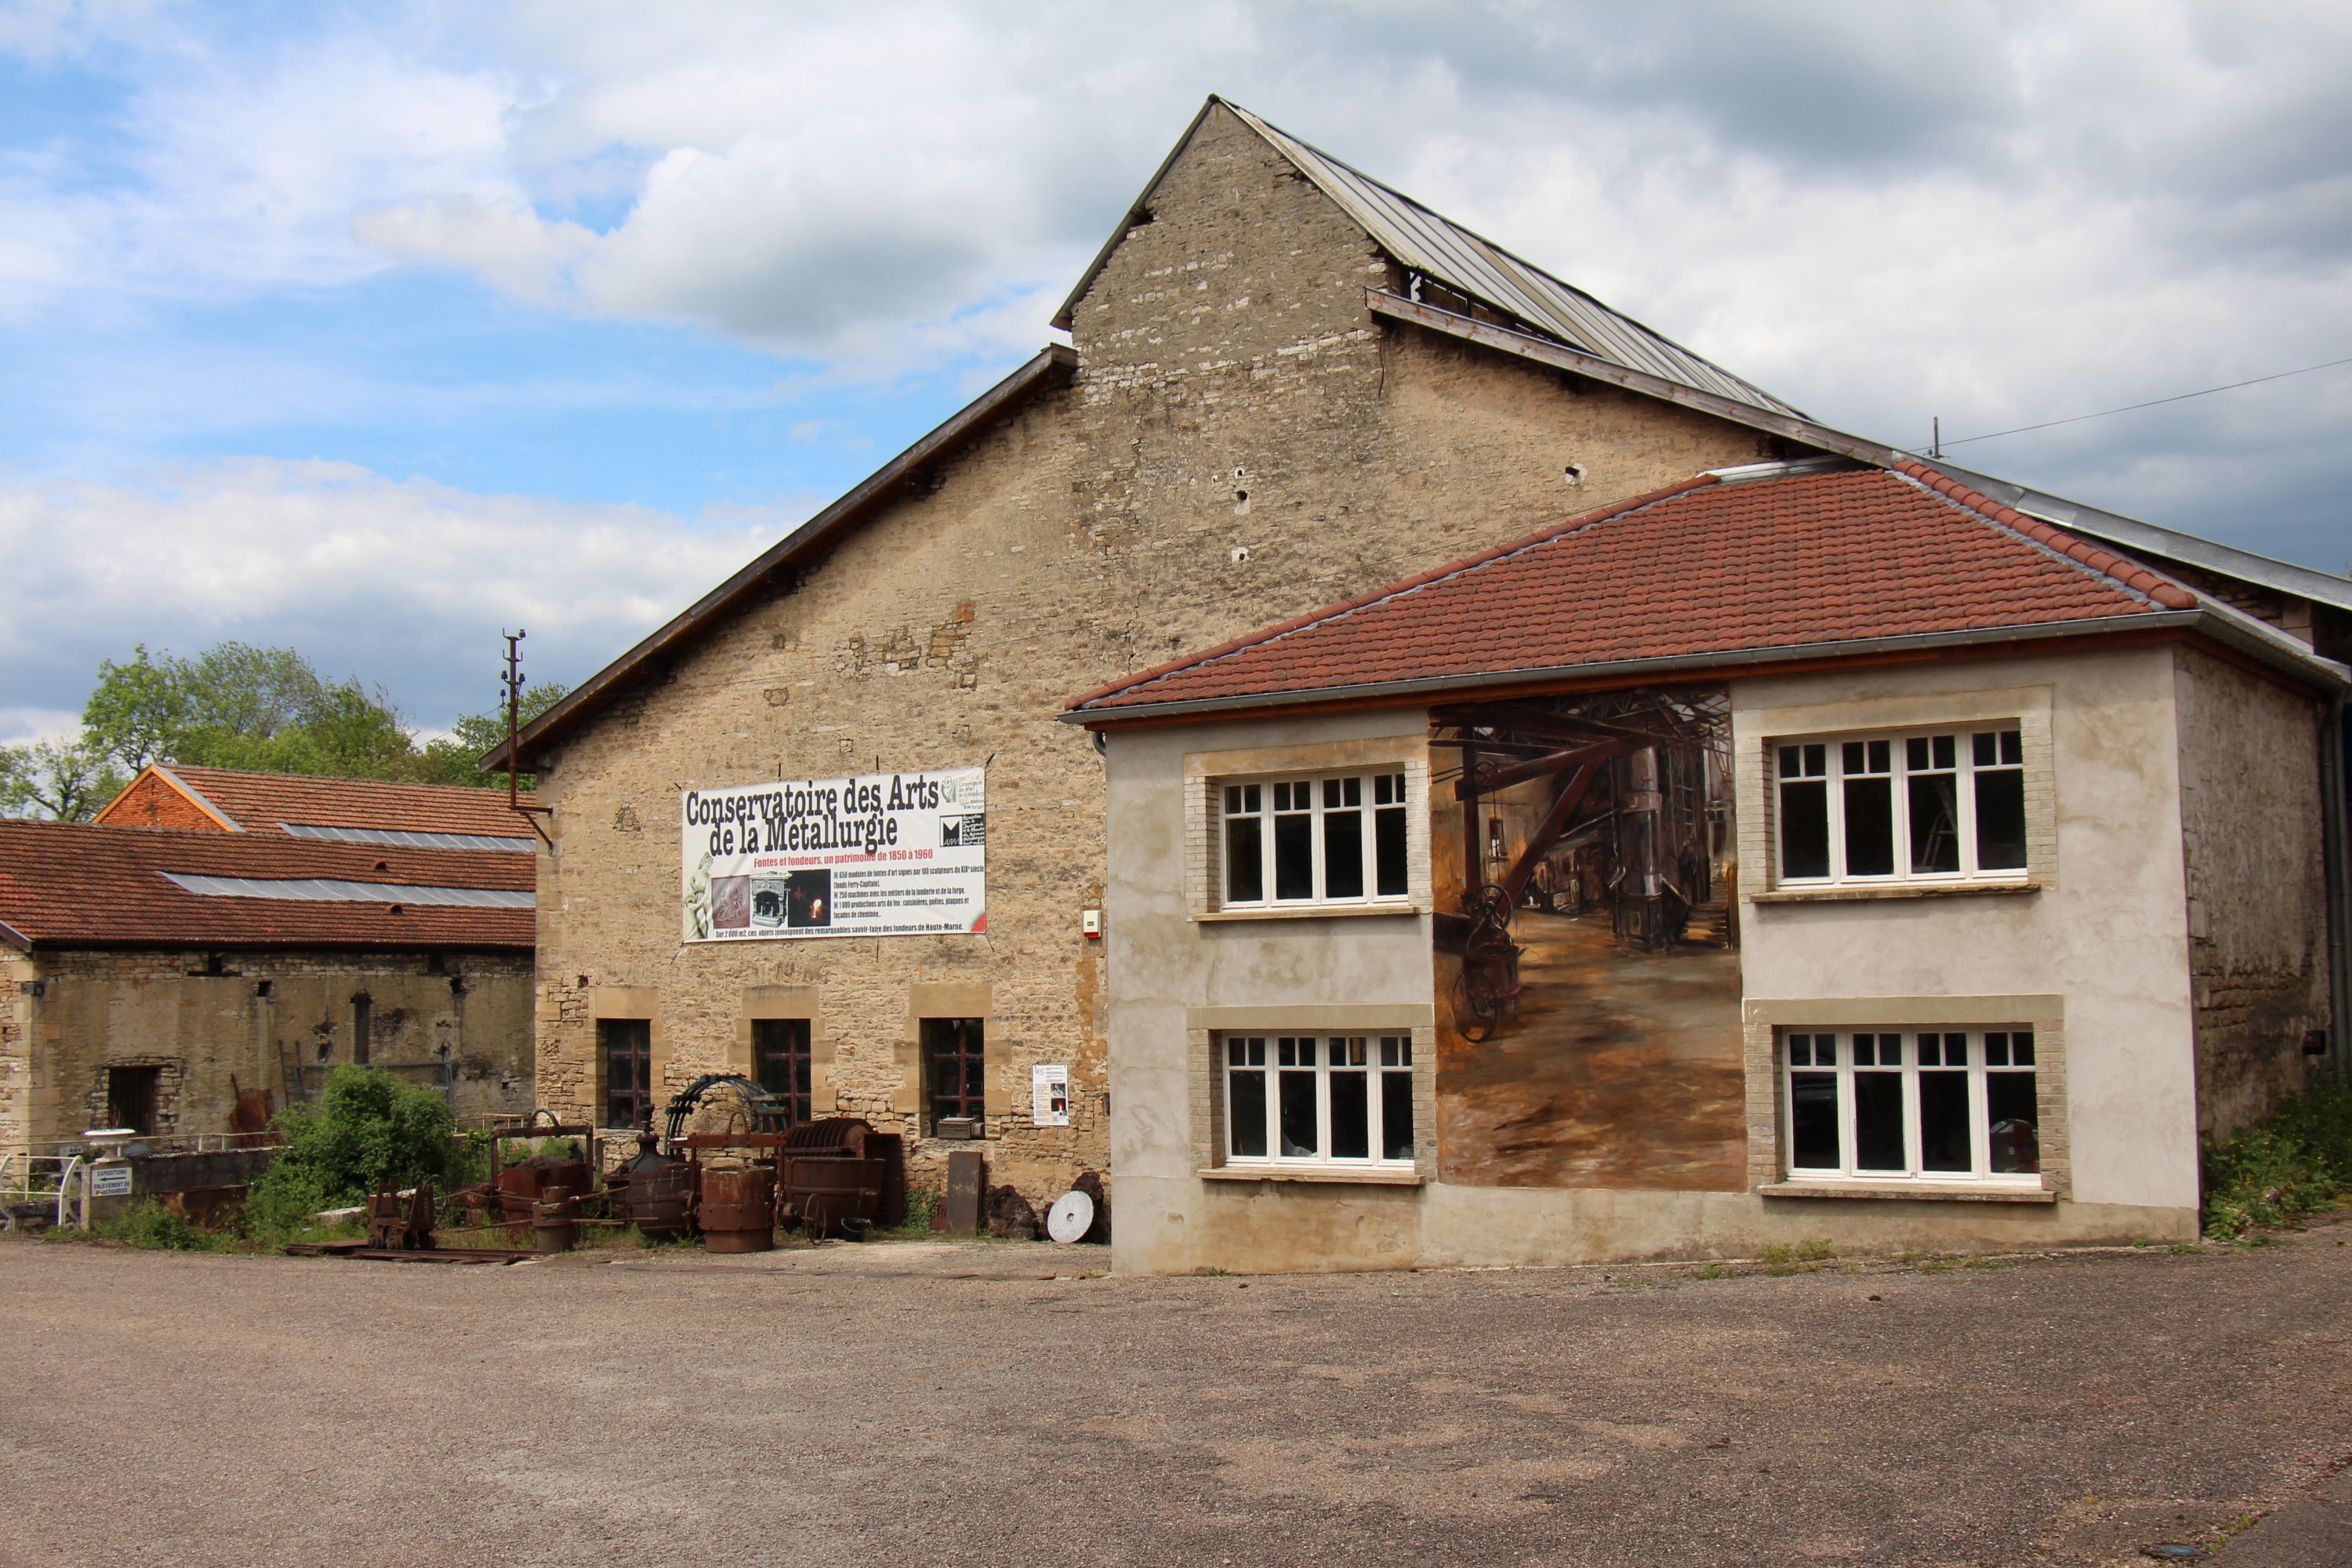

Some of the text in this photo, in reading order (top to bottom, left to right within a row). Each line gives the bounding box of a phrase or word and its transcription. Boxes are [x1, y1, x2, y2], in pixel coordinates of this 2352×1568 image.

[687, 775, 938, 826] Conservatoire des Arts
[710, 808, 898, 857] de la Métallurgie
[754, 848, 933, 868] Fontes et fondeurs, un patrimoine de 1850 à 1960
[898, 868, 913, 877] signés
[930, 866, 953, 875] sculpteurs
[887, 888, 905, 897] métiers
[851, 900, 877, 909] productions
[946, 897, 964, 906] plaques
[833, 911, 851, 920] façades
[758, 928, 774, 937] objets
[775, 927, 804, 937] témoignent
[815, 926, 851, 935] remarquables
